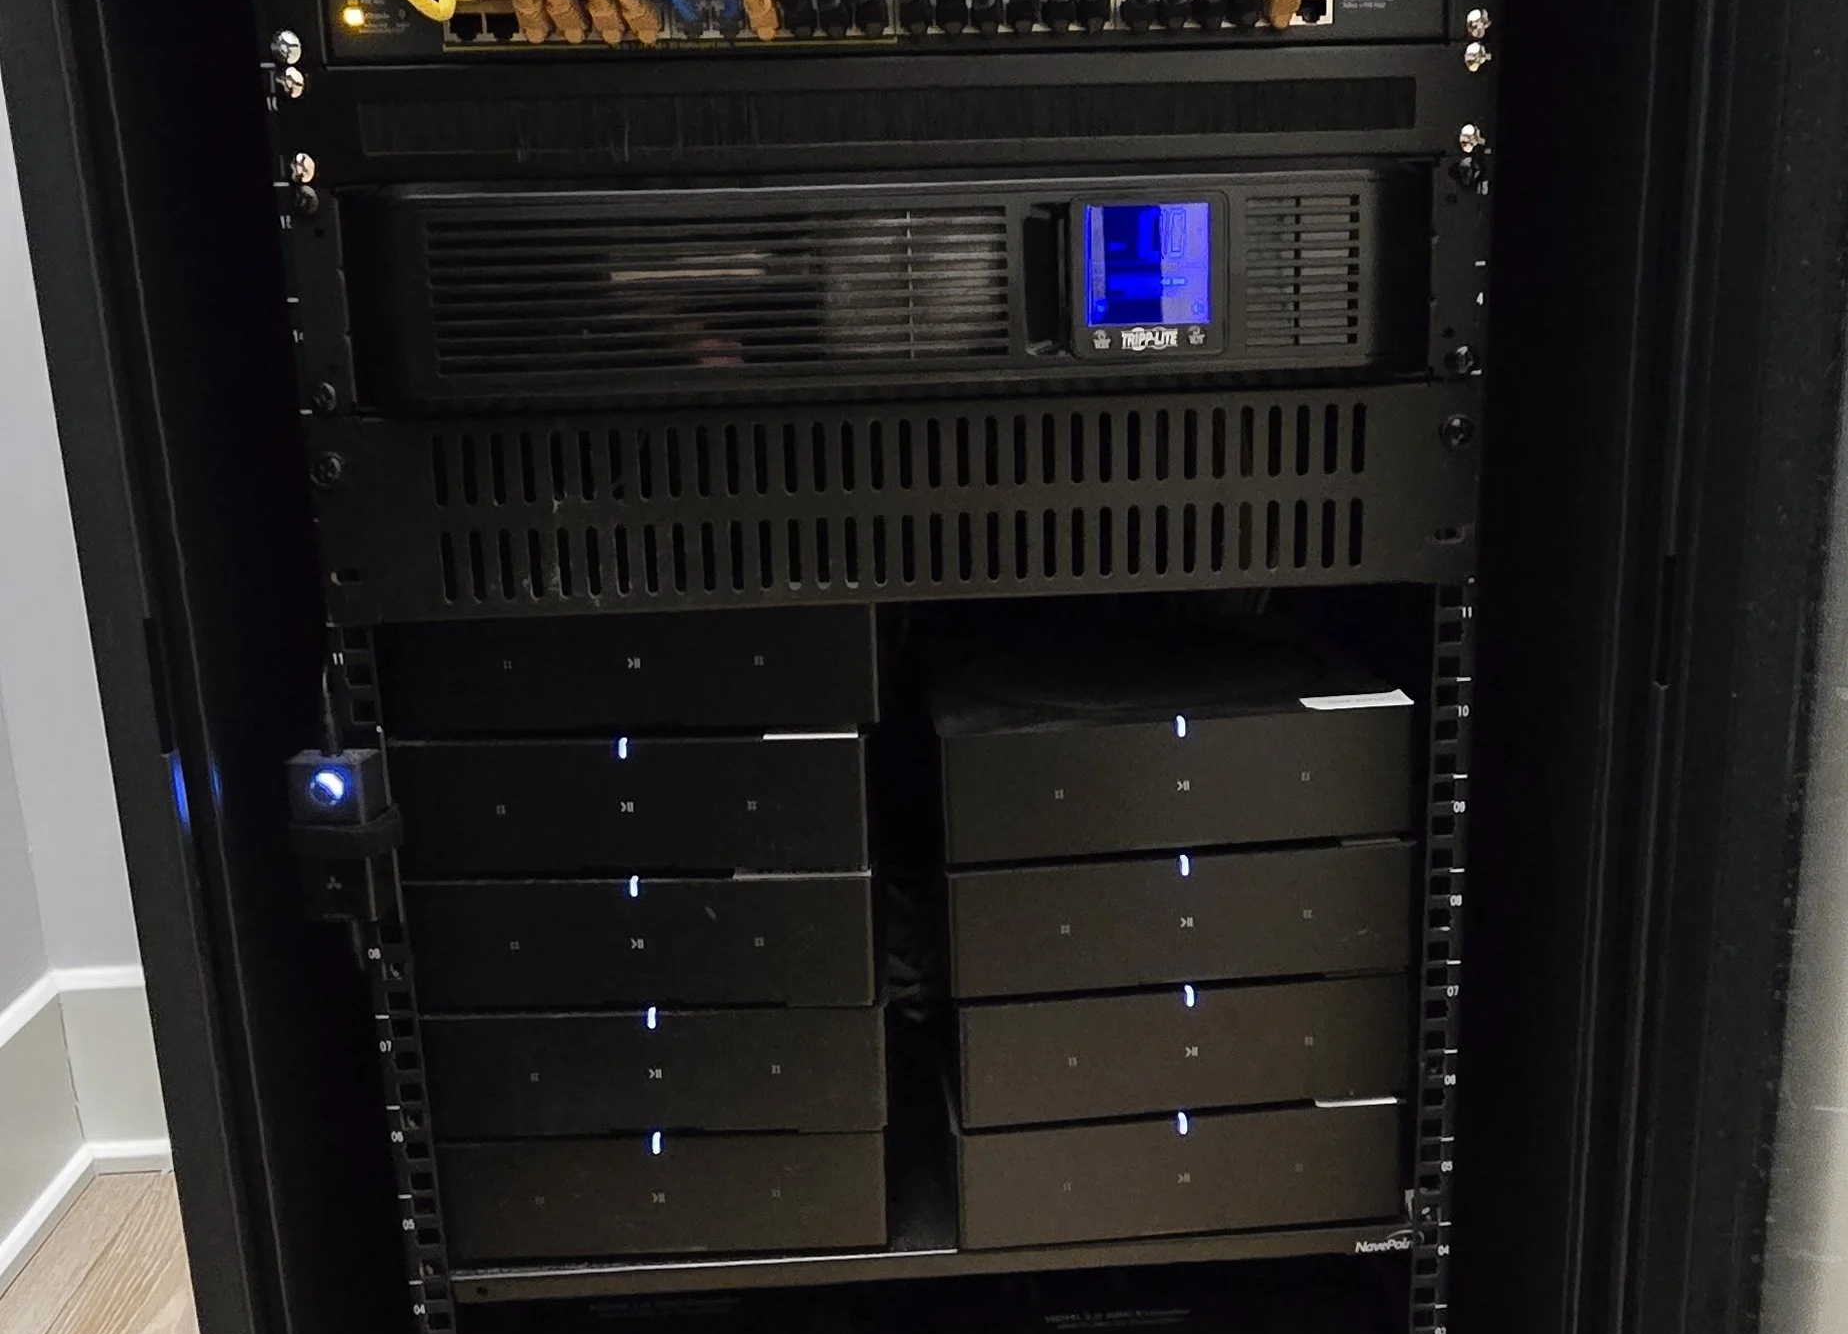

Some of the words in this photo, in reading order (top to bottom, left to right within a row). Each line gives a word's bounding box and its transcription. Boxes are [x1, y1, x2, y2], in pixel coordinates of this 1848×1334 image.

[1462, 606, 1473, 619] 11
[332, 652, 344, 665] 11
[1458, 704, 1469, 718] 10
[1447, 985, 1459, 997] 07
[379, 1040, 392, 1053] 07
[402, 1218, 415, 1231] 05
[1437, 1245, 1450, 1256] 04
[413, 1304, 426, 1315] 04
